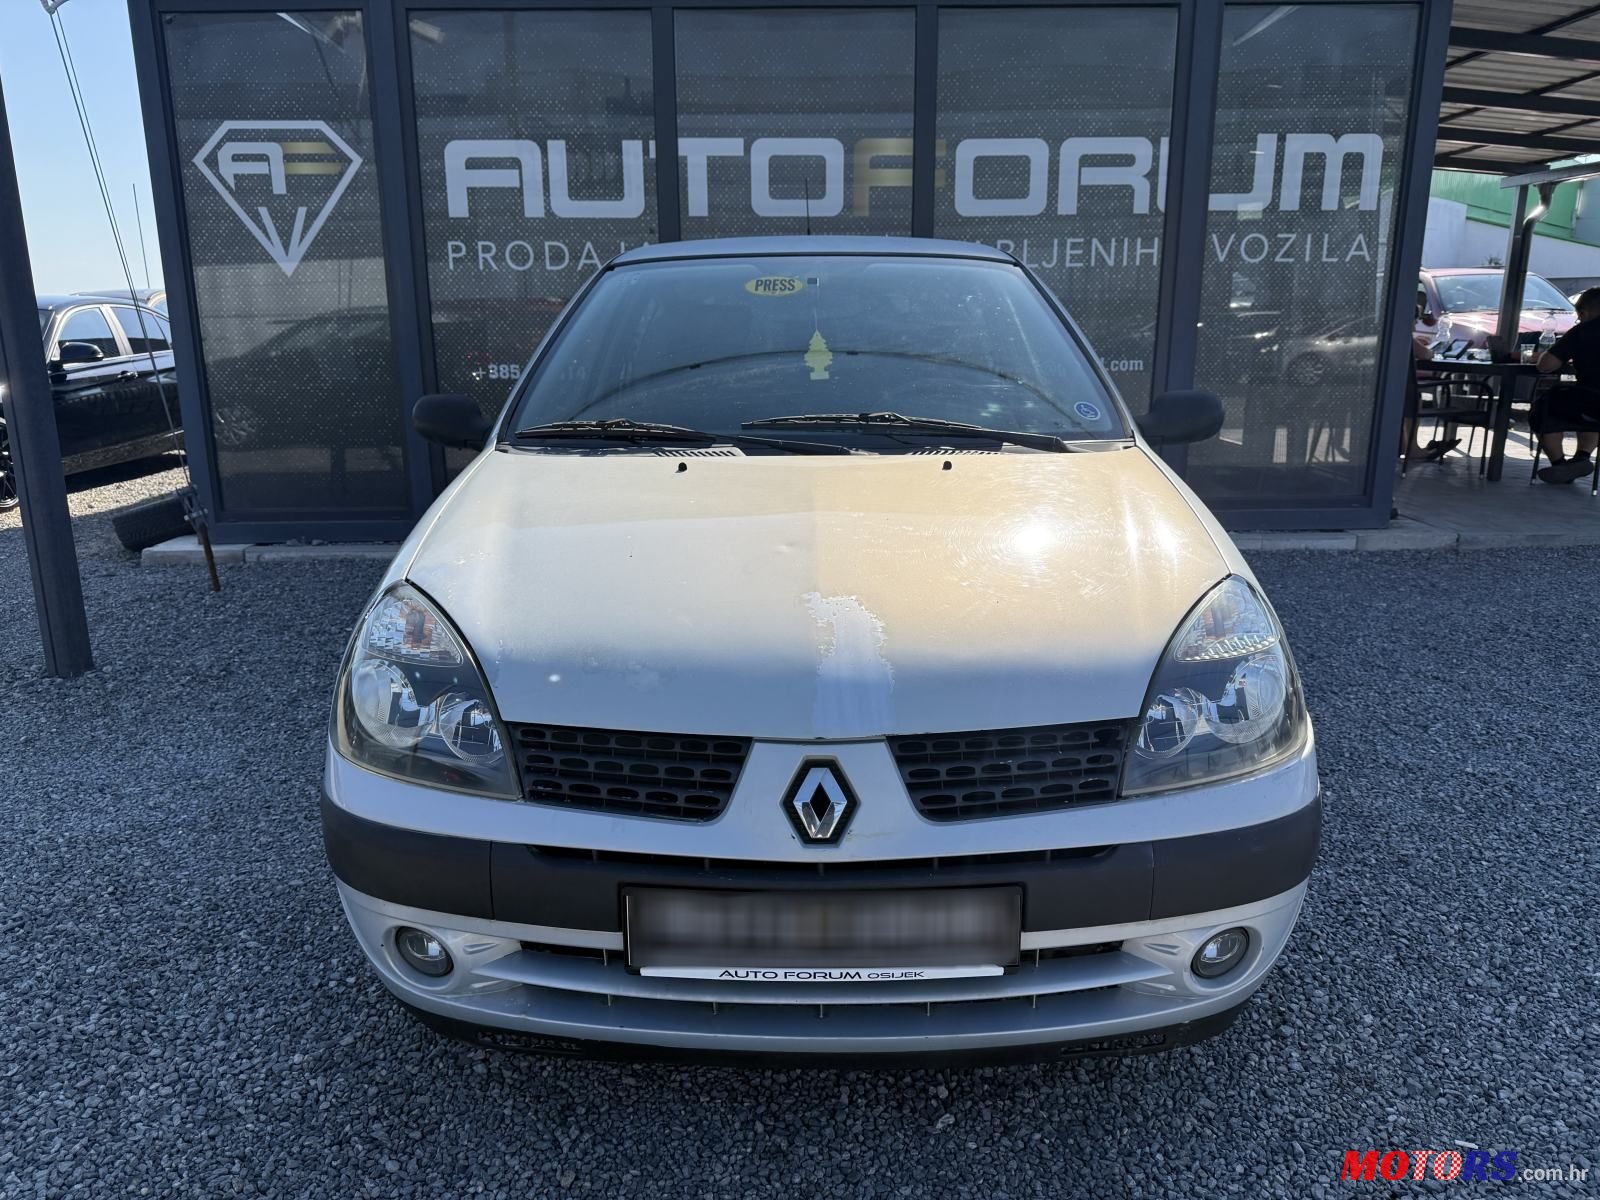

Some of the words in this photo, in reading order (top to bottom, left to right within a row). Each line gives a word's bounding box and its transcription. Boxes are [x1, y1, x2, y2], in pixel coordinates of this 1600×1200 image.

[447, 240, 649, 271] PRODA
[1212, 233, 1371, 263] VOZILA
[755, 279, 796, 292] PRESS
[475, 364, 521, 379] +385
[718, 970, 778, 979] AUTO
[784, 970, 862, 980] FORUM
[867, 971, 925, 979] OSIJEK
